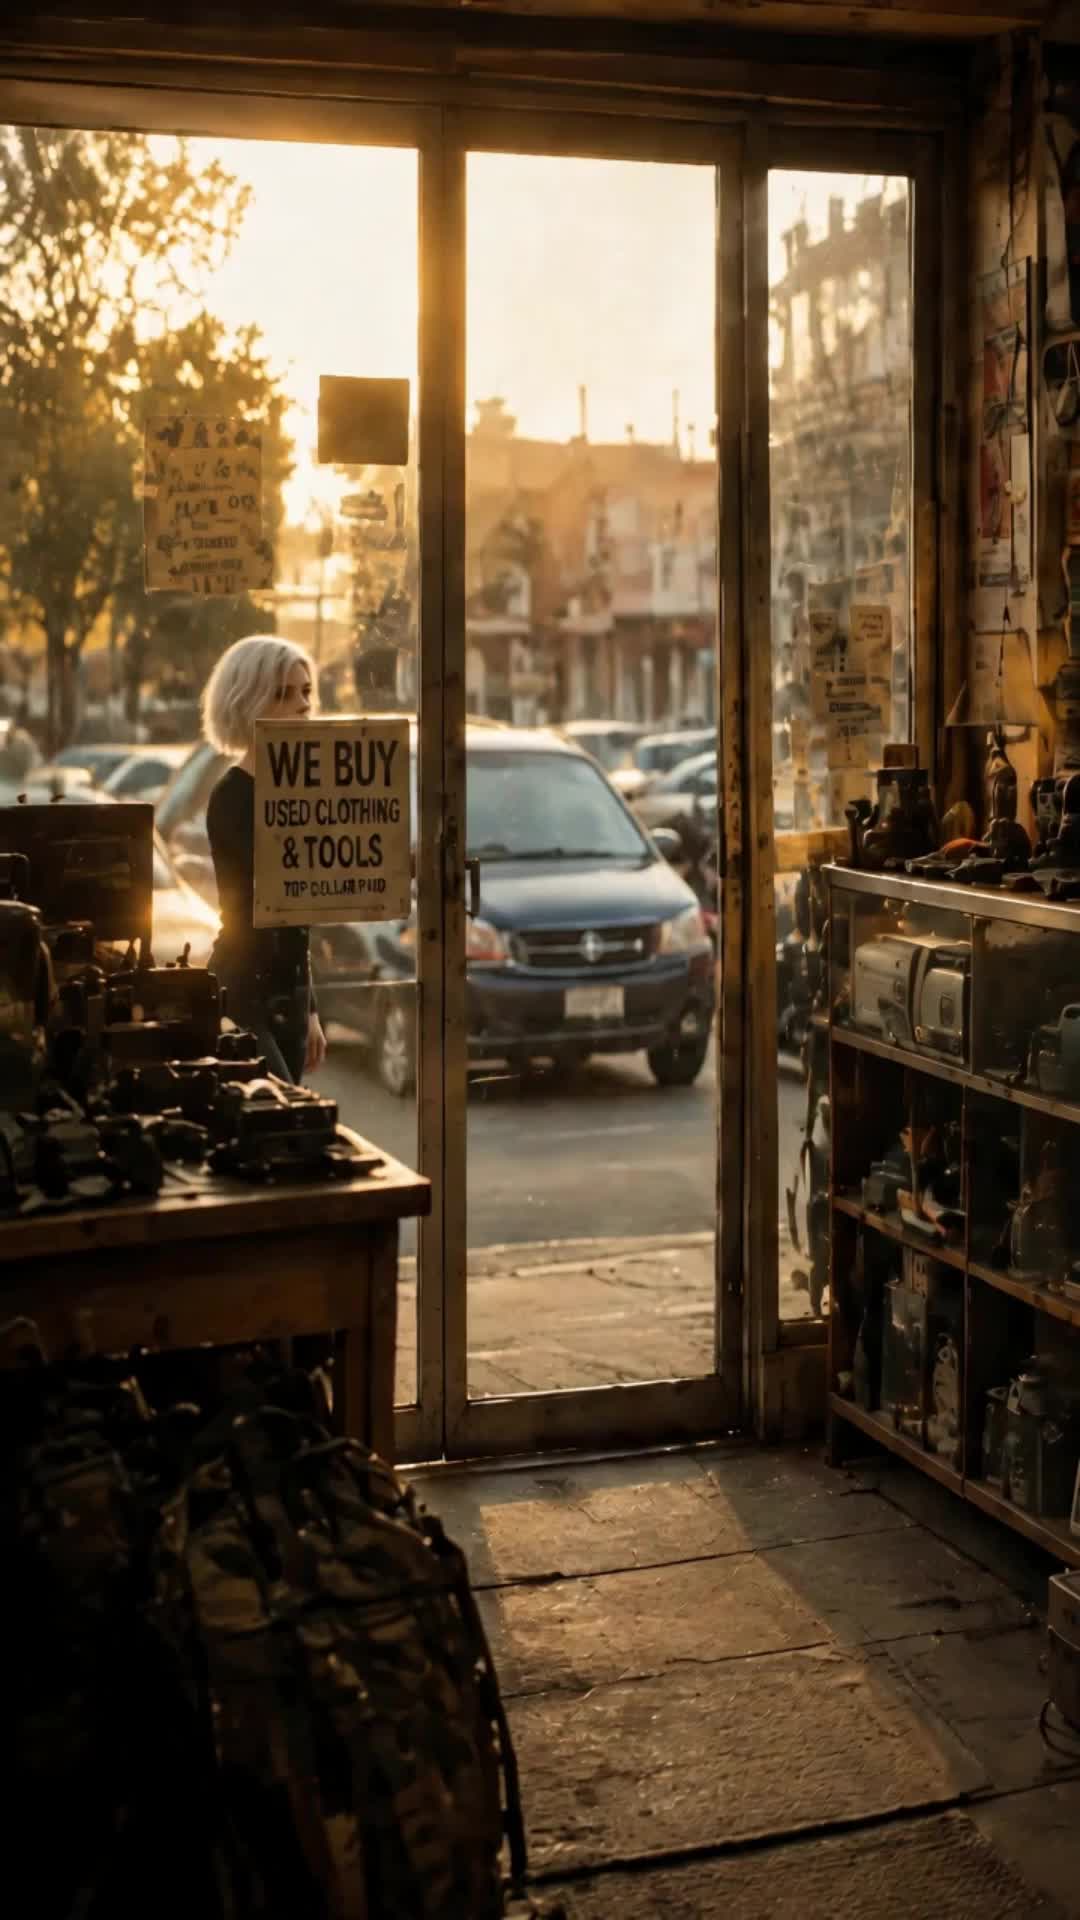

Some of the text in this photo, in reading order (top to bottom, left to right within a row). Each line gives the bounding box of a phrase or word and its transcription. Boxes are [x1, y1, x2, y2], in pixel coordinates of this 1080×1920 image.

[267, 740, 398, 787] WE BUY
[265, 798, 400, 826] USED CLOTHING
[282, 833, 383, 868] & TOOLS
